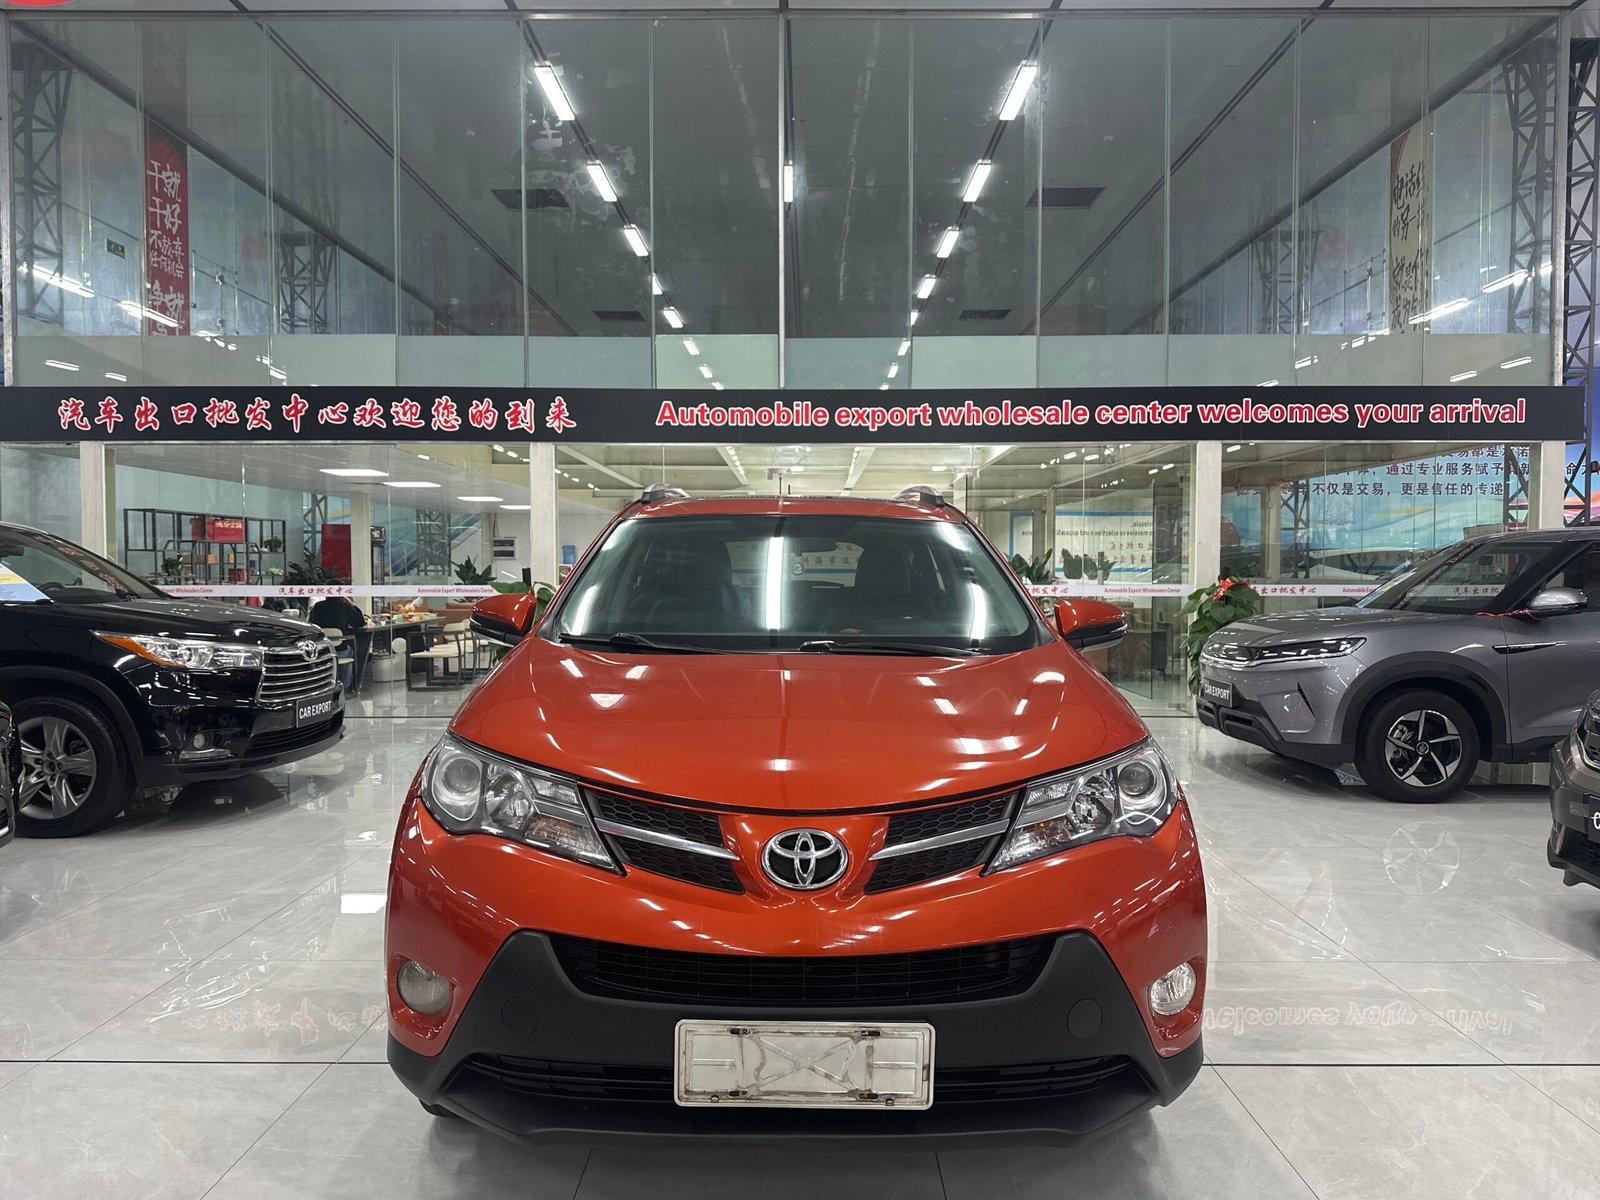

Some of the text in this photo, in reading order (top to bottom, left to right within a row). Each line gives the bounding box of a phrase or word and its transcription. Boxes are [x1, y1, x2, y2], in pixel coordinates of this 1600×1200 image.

[58, 393, 577, 434] 汽车出口批发中心欢迎您的到来
[655, 398, 1526, 431] Automobile export wholesale center welcomes your arrival
[278, 586, 353, 595] 汽车出口批发中心
[1027, 586, 1069, 595] 批发中心
[1212, 686, 1230, 700] EXPORT
[299, 700, 332, 720] CAR EXPORT
